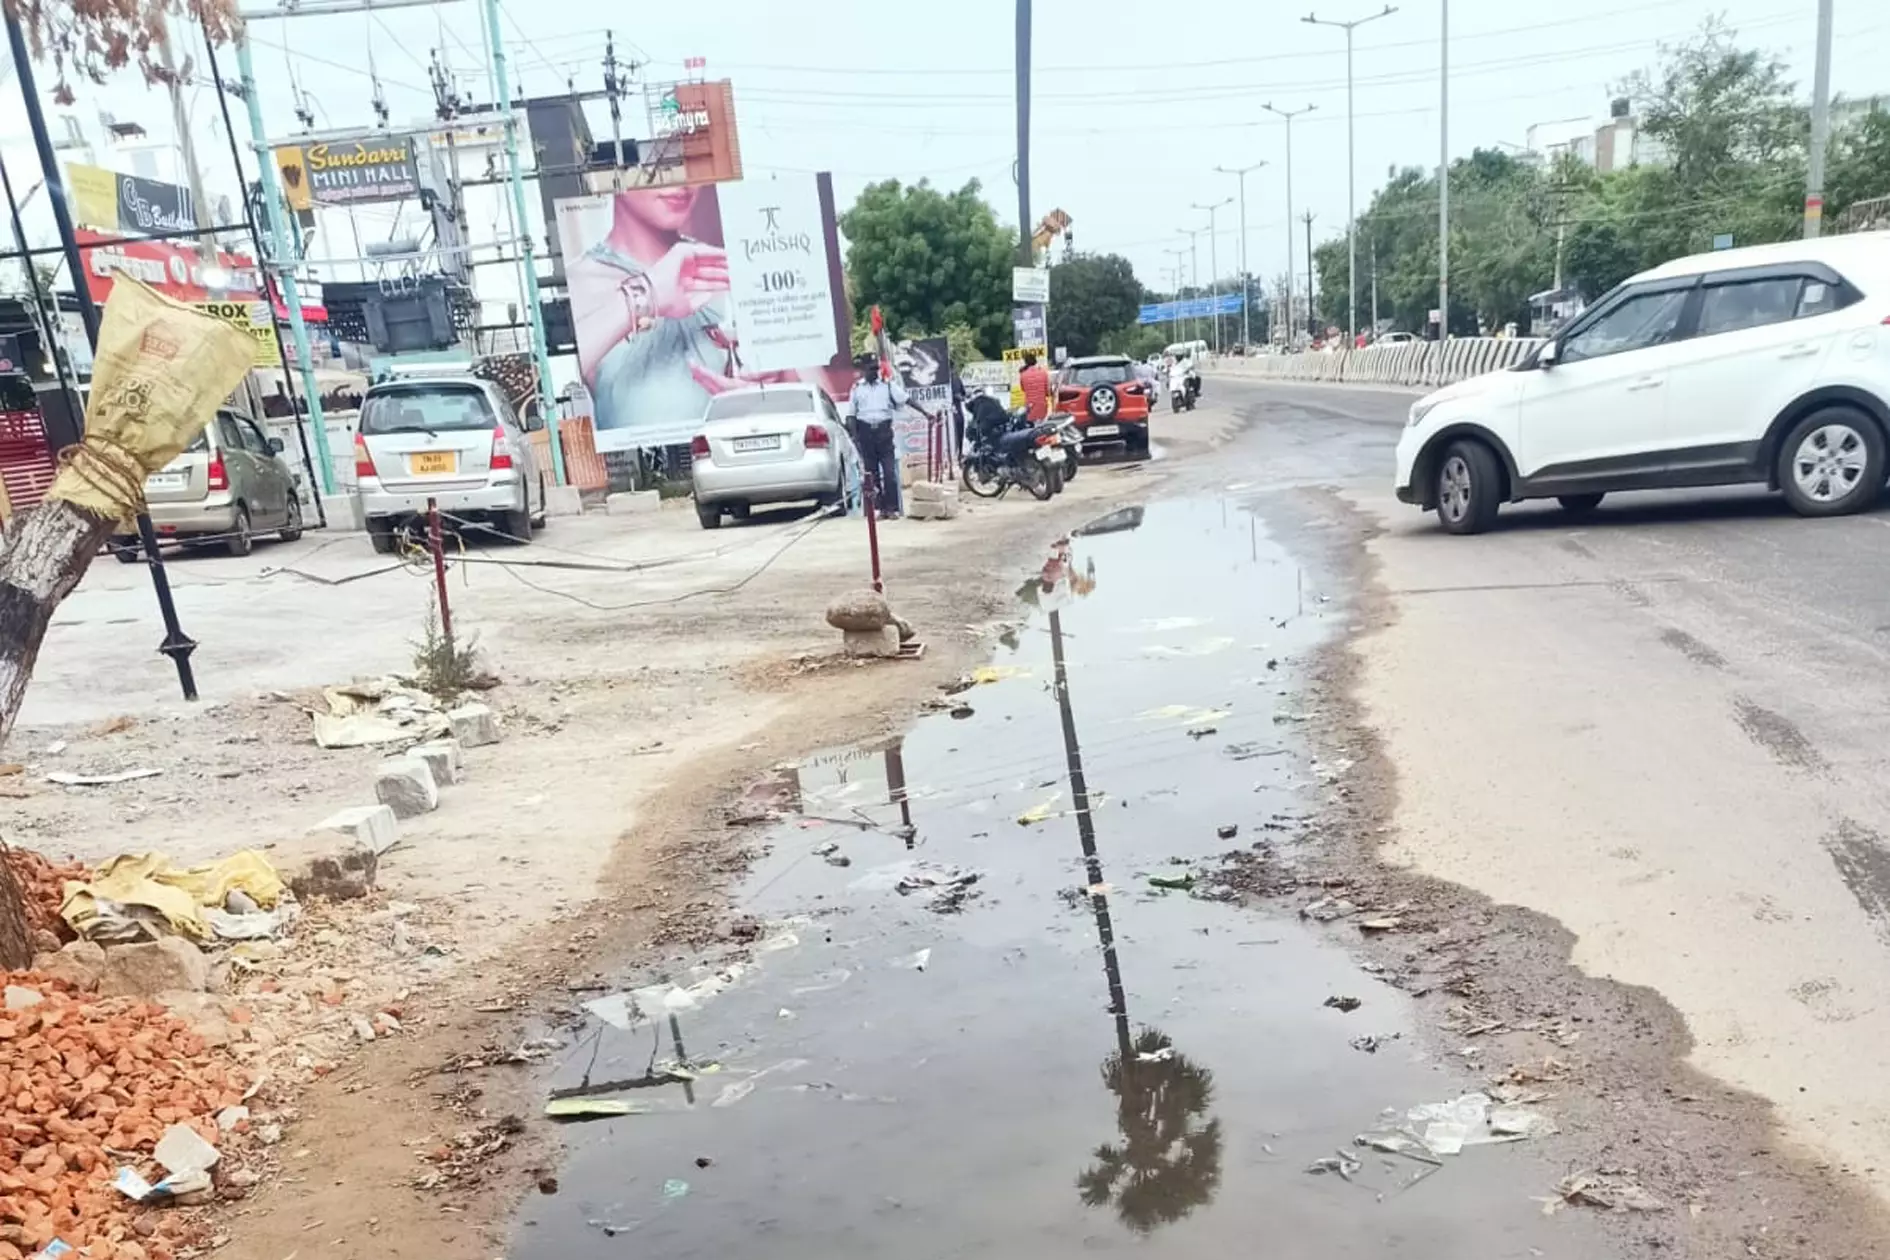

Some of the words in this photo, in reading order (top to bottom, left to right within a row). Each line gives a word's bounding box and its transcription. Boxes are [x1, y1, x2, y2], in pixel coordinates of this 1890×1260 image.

[313, 168, 360, 188] MINI
[365, 165, 413, 185] HALL
[194, 303, 248, 319] ROX
